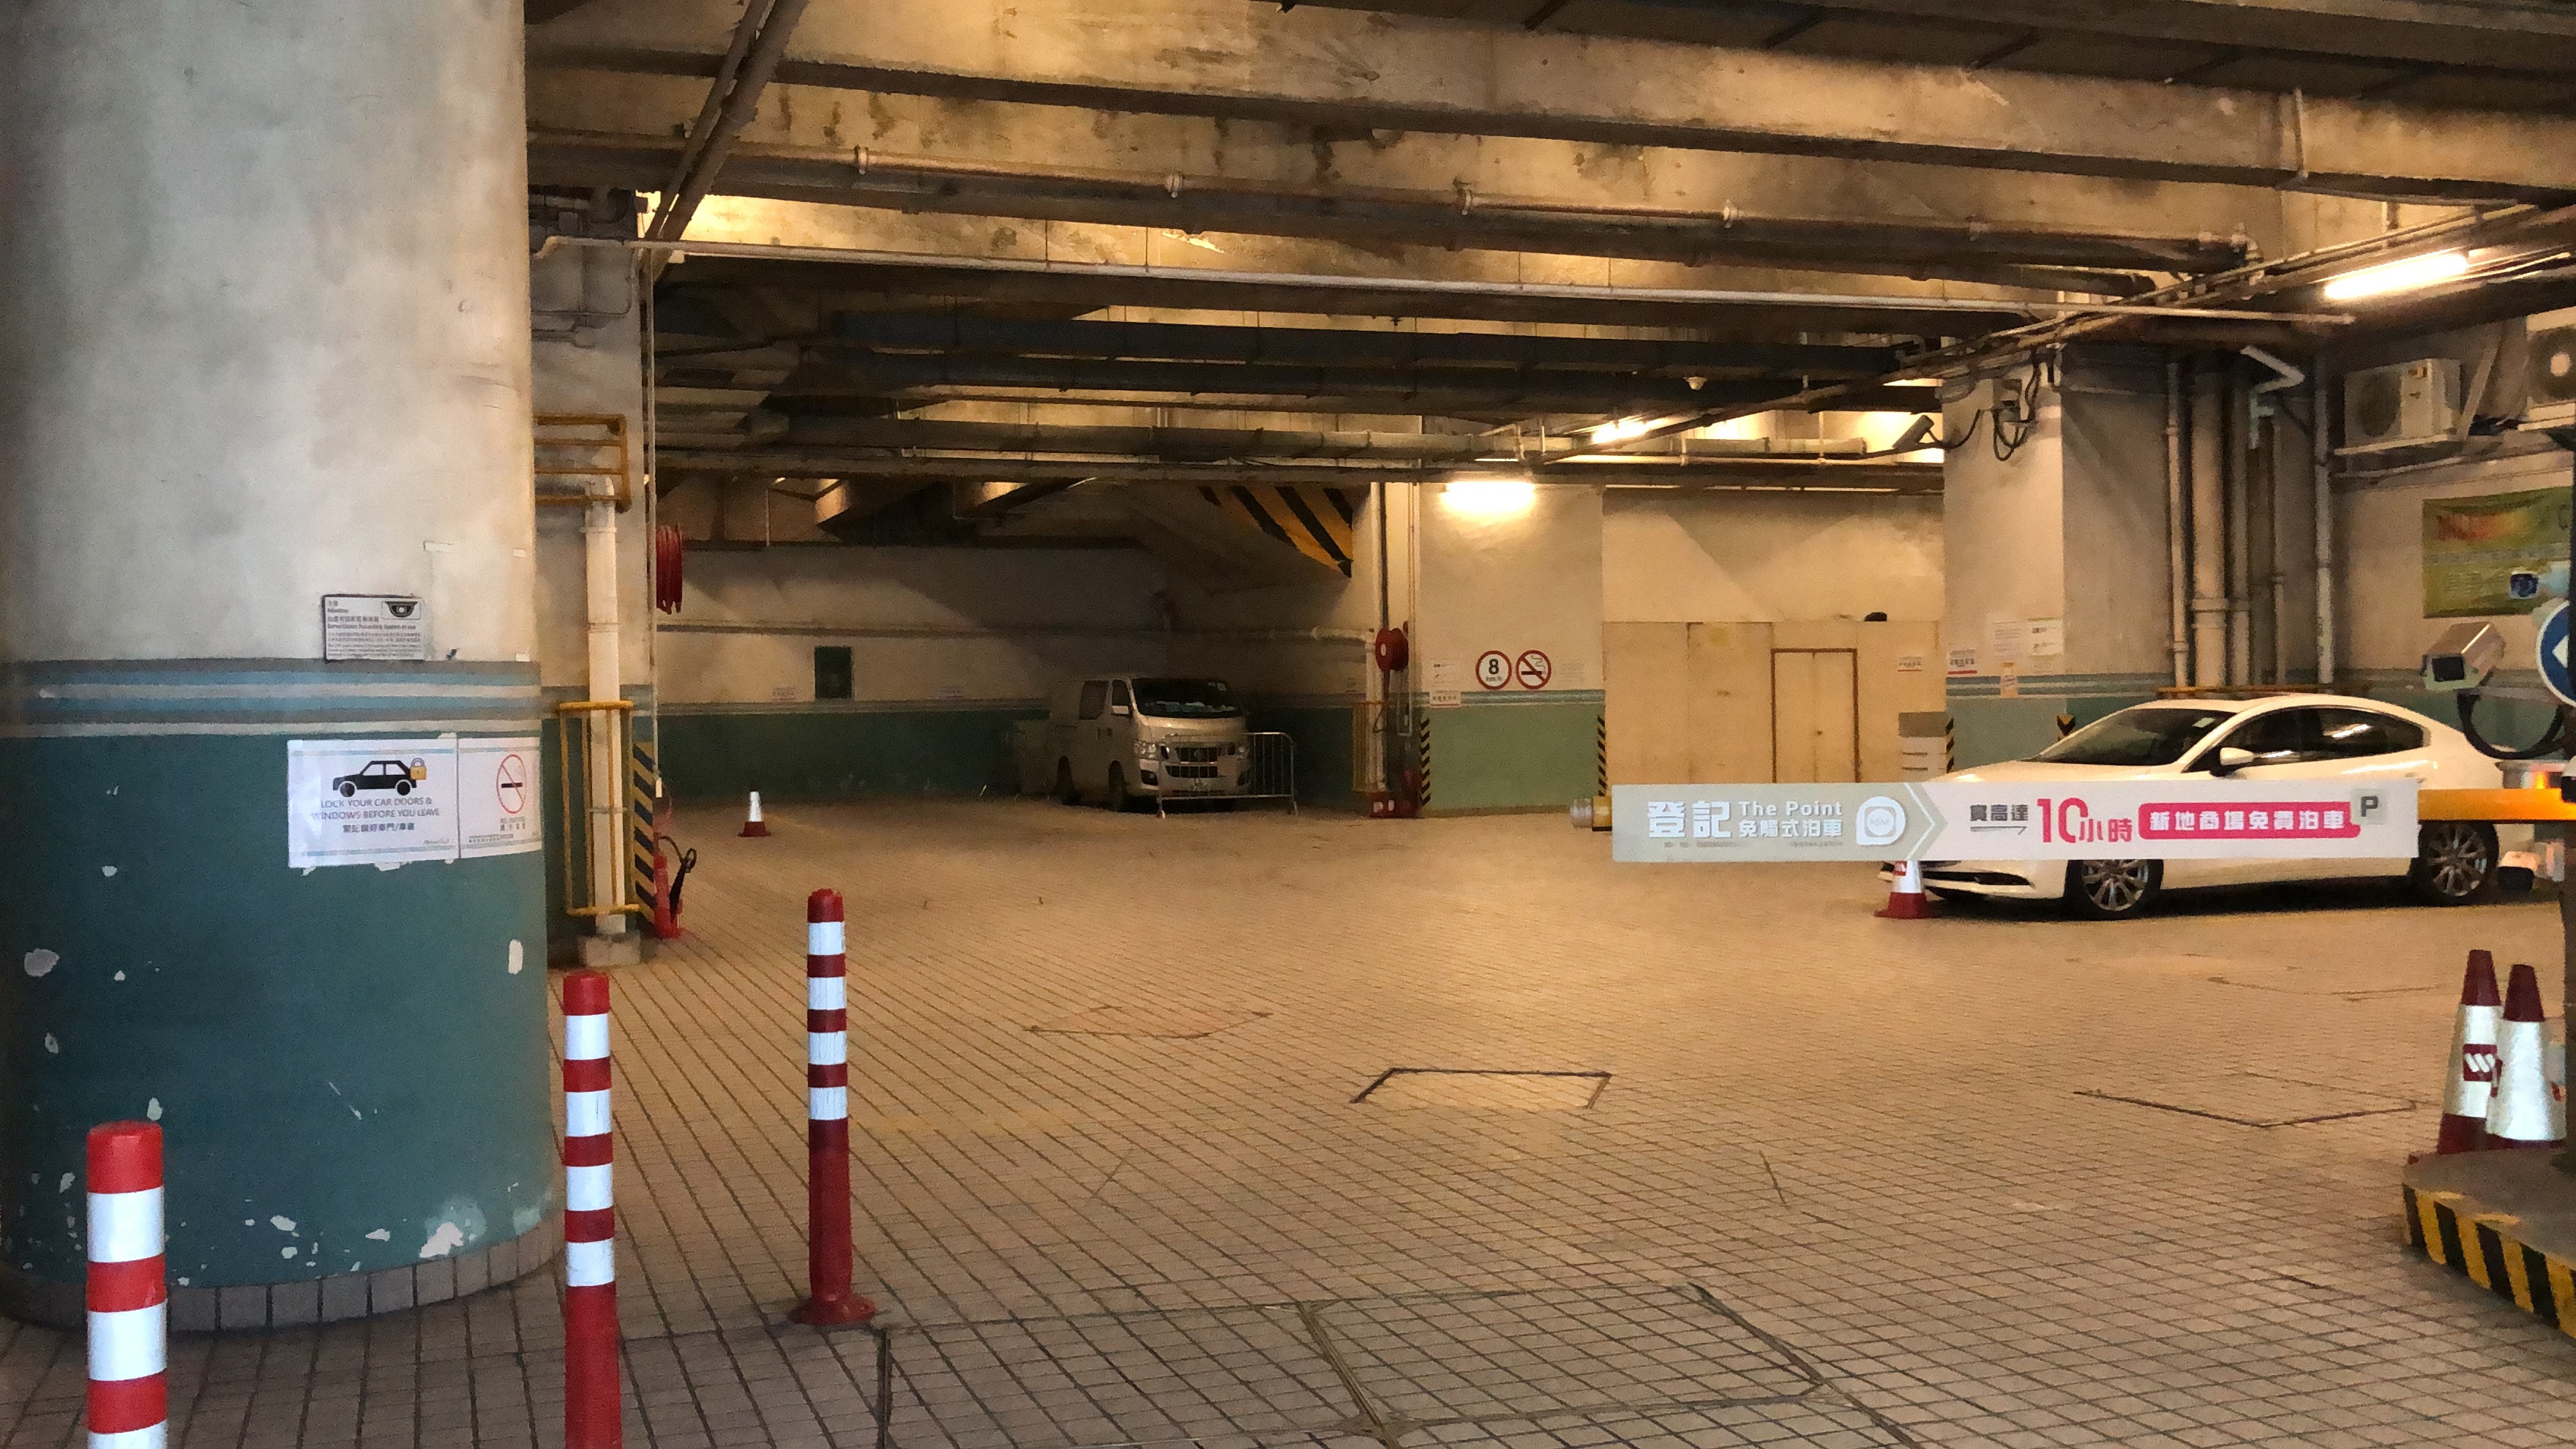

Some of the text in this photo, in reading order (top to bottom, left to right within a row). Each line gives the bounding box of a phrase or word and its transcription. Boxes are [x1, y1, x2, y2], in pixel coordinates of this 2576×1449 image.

[1489, 659, 1499, 675] 8
[321, 797, 433, 808] LOCK YOUR CAR DOORS &
[1738, 801, 1843, 817] The Point
[2360, 795, 2379, 817] P
[311, 808, 440, 820] WINDOWS BEFORE YOU LEAVE
[1647, 800, 1732, 839] 登記
[2149, 810, 2345, 831] 新地商場免費泊車
[1738, 819, 1843, 837] 免觸式泊車
